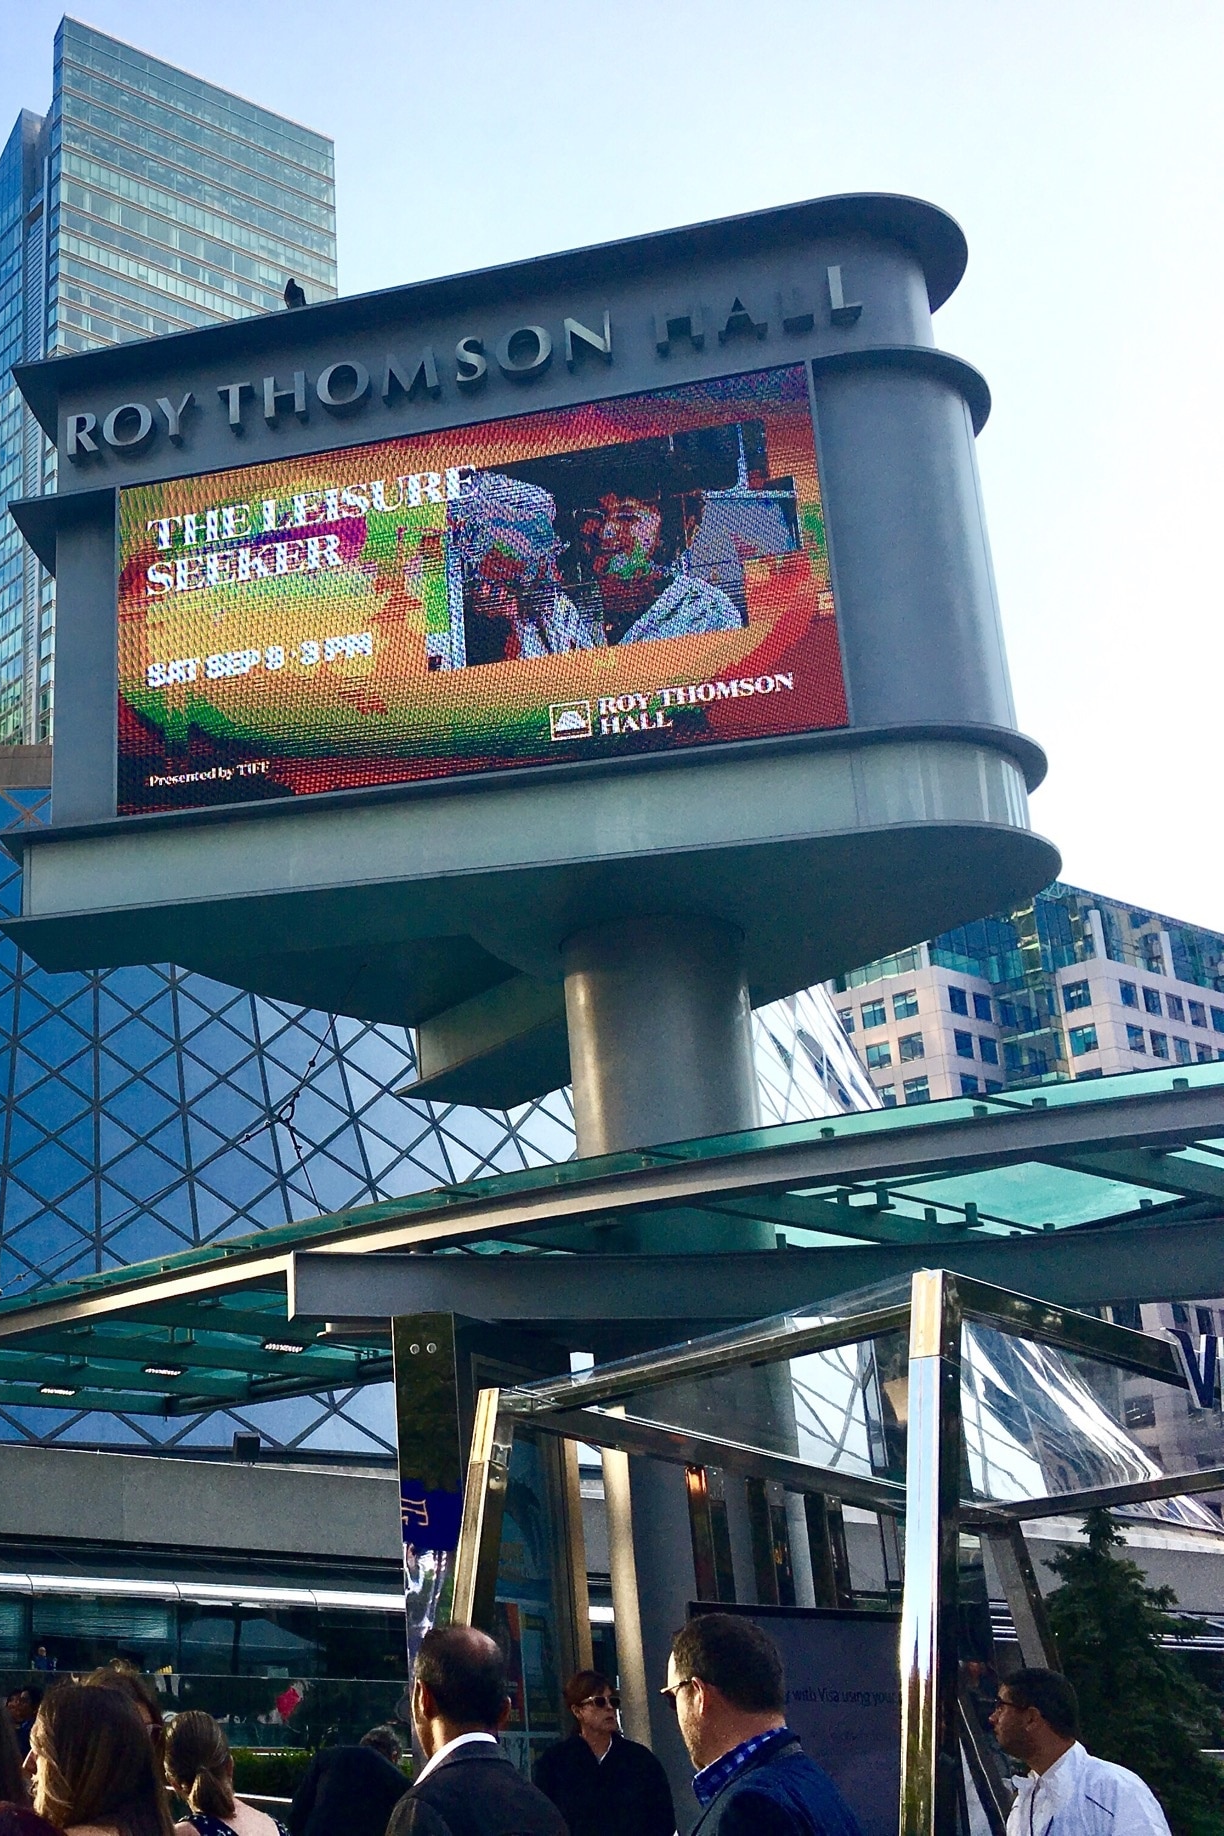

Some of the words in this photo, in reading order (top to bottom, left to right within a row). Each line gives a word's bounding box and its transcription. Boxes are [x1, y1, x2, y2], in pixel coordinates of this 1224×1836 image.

[66, 392, 196, 463] ROY
[216, 310, 615, 433] THOMSON
[654, 264, 864, 357] HALL
[147, 504, 252, 551] THE
[260, 465, 478, 532] LEISURE
[145, 533, 343, 596] SEEKER
[147, 659, 200, 687] SAT
[204, 649, 262, 679] SEP
[597, 691, 654, 714] ROY
[656, 672, 795, 706] THOMSON
[599, 711, 674, 735] HALL
[149, 767, 217, 787] Presented
[217, 765, 234, 781] by
[236, 760, 271, 776] TIFF
[793, 1687, 817, 1702] with
[817, 1687, 840, 1702] Visa
[842, 1692, 870, 1706] using
